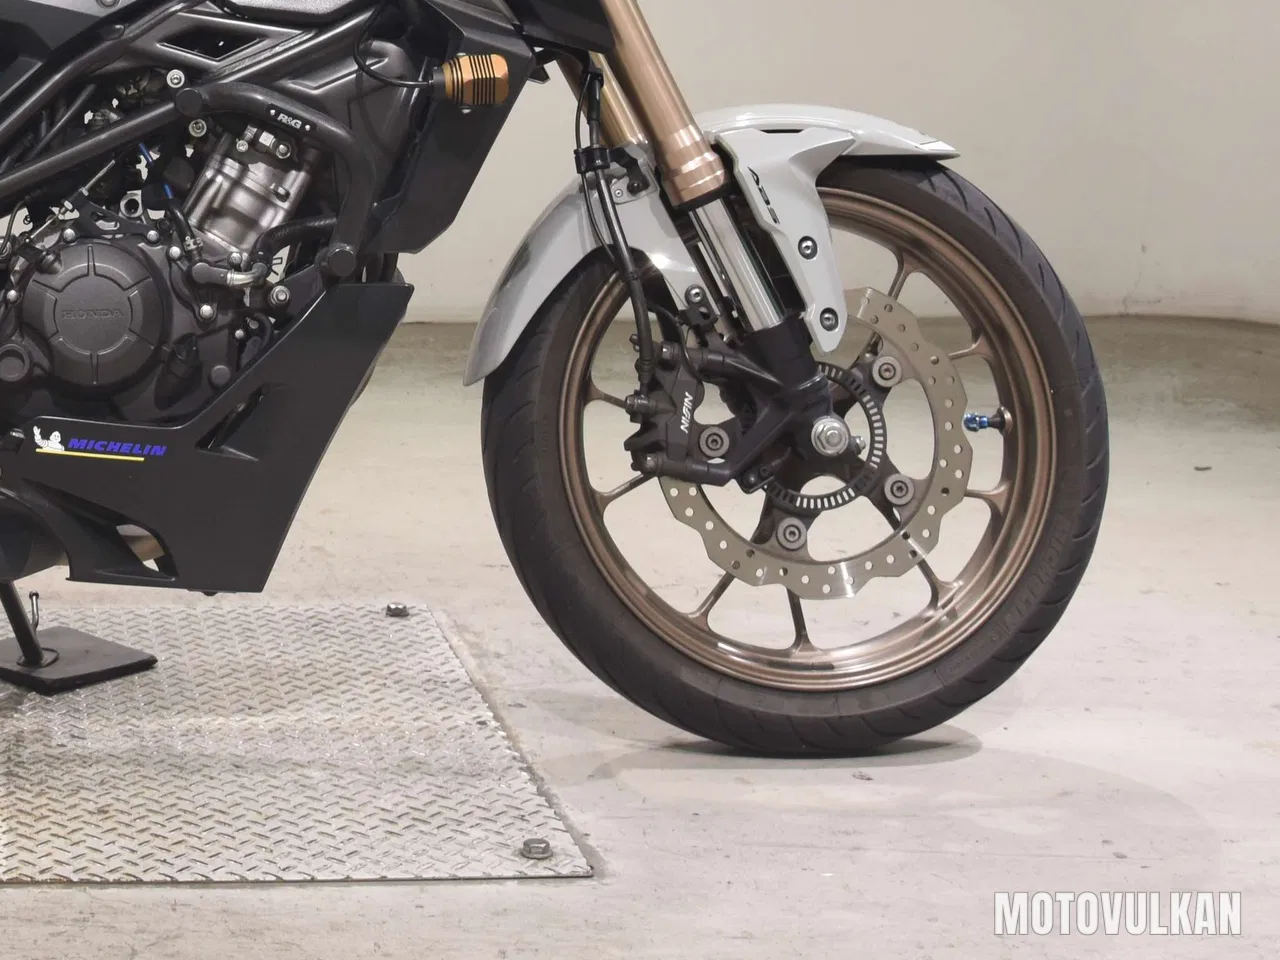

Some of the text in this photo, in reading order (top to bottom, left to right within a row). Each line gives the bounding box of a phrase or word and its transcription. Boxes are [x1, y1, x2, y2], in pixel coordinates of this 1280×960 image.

[277, 113, 302, 129] R&G
[62, 309, 124, 320] HONDA
[68, 438, 168, 457] MICHELIN
